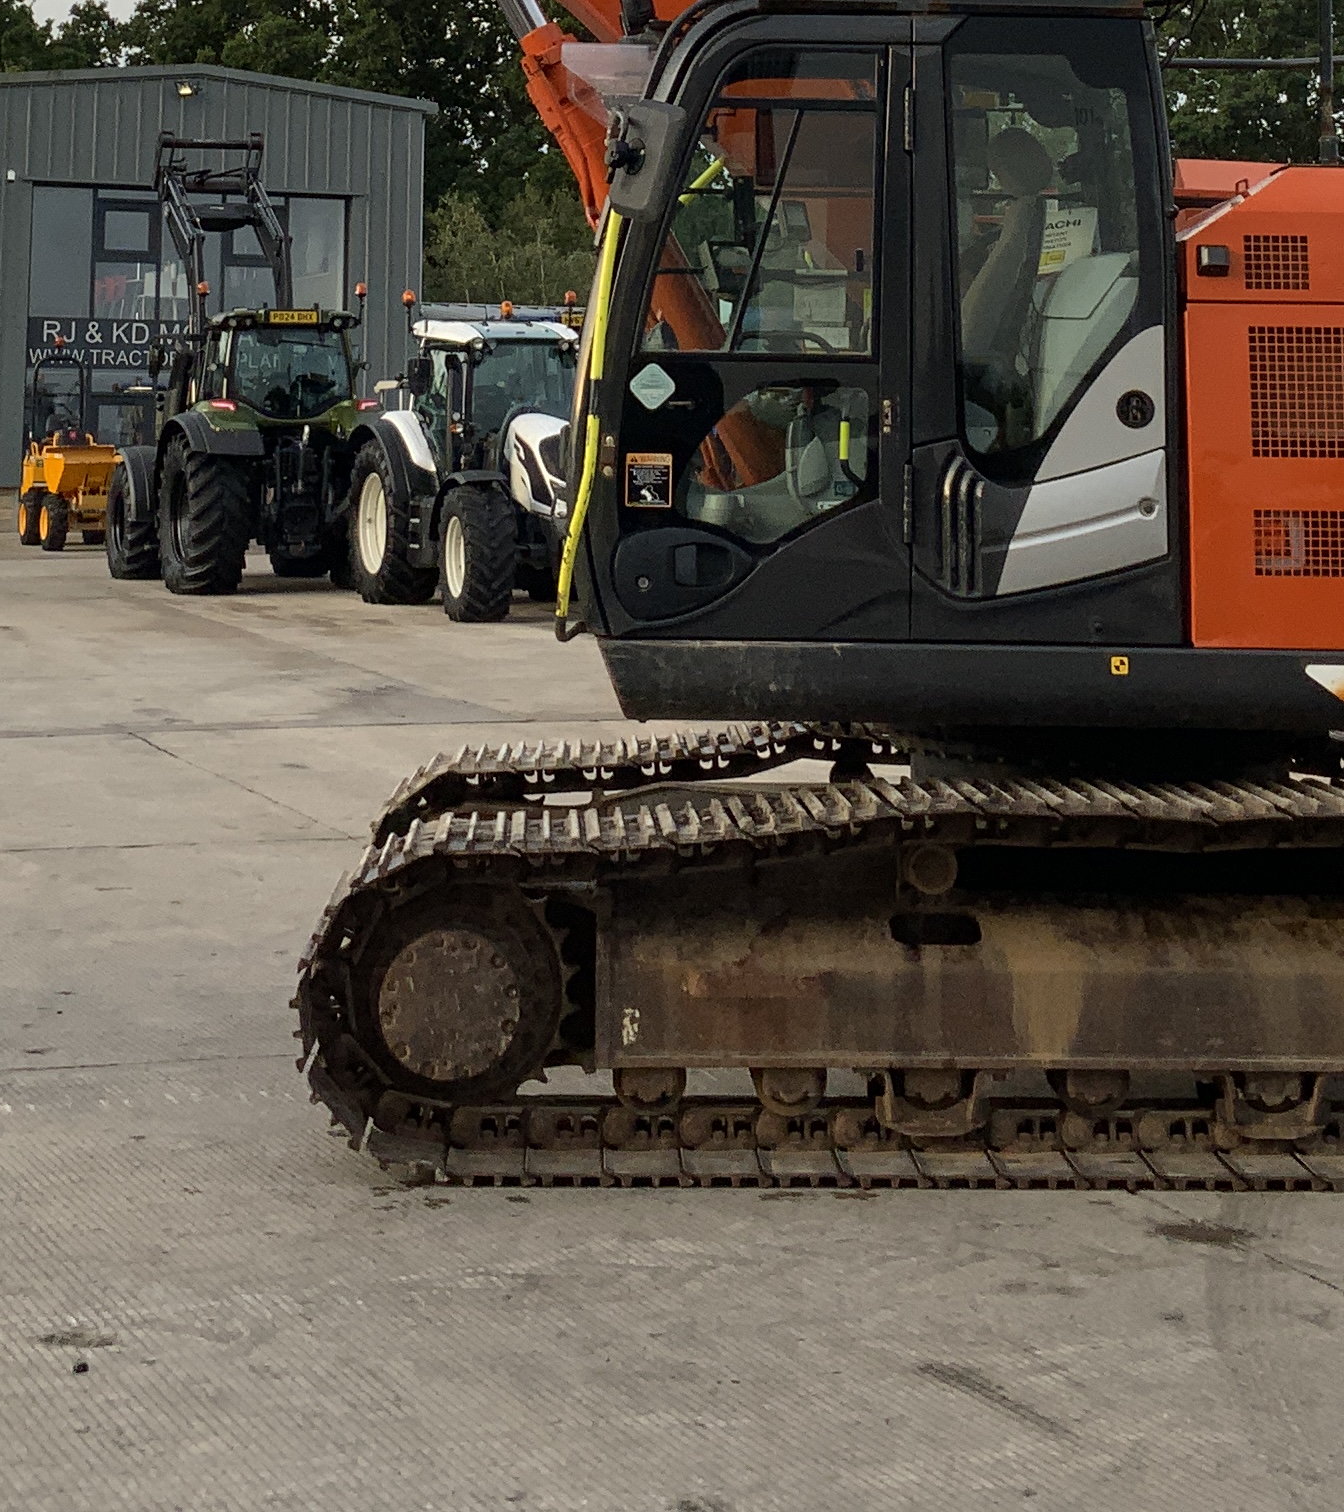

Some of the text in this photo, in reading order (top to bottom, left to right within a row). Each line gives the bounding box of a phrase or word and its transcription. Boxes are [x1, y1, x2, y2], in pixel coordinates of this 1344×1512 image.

[43, 320, 76, 343] RJ
[85, 321, 103, 344] &
[112, 322, 150, 345] KD
